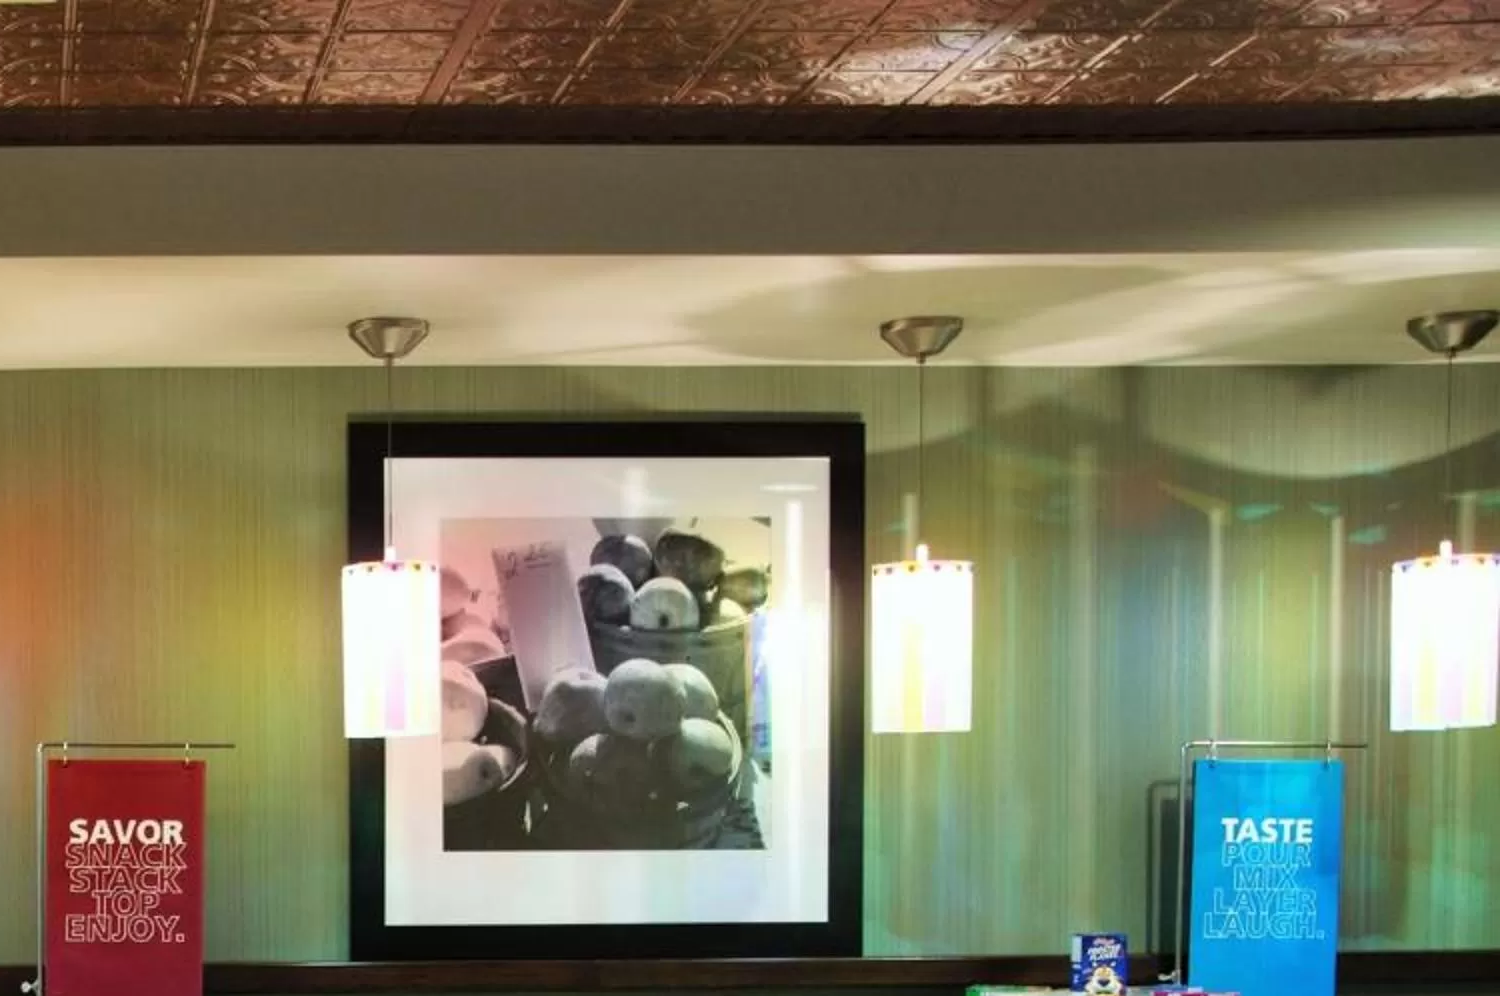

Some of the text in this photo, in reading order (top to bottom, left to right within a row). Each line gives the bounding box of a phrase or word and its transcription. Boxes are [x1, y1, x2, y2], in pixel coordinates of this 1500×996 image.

[69, 819, 183, 844] SAVOR
[1221, 818, 1313, 843] TASTE
[65, 842, 187, 868] SNACK
[1221, 841, 1311, 867] POUR
[70, 866, 182, 893] STACK
[1233, 864, 1298, 890] MIX
[92, 890, 159, 916] TOP
[1214, 888, 1317, 914] LAYER
[65, 914, 185, 942] ENJOY.
[1204, 912, 1325, 939] LAUGH.
